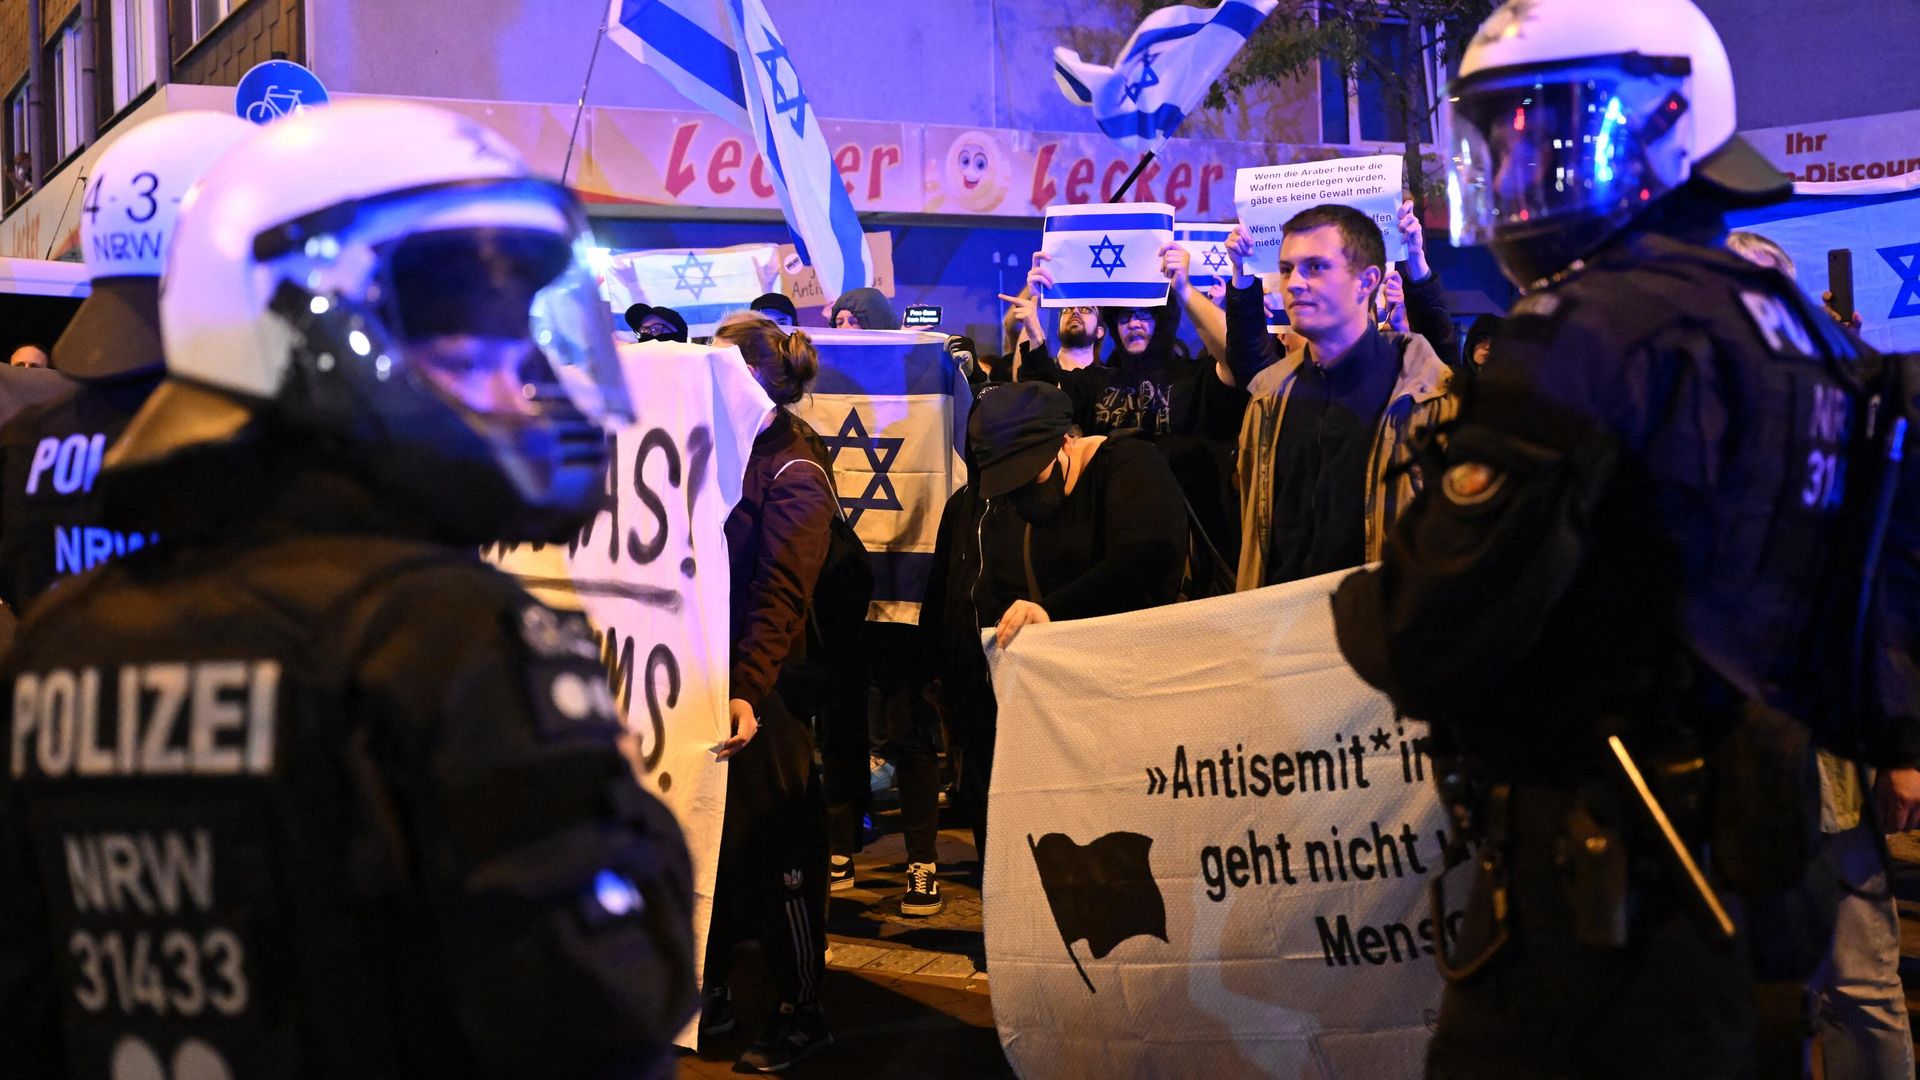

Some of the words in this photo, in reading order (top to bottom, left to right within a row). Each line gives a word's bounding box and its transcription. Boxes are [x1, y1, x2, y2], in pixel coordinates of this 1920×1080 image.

[664, 123, 899, 200] Lecer
[1031, 143, 1224, 212] Lecker
[1254, 172, 1281, 180] Wenn
[1284, 170, 1298, 178] die
[1301, 168, 1335, 176] Araber
[1337, 164, 1365, 173] heute
[1368, 162, 1383, 170] die
[1785, 132, 1827, 155] Ihr
[1249, 183, 1283, 192] Waffen
[1285, 177, 1343, 189] niederlegen
[1346, 173, 1386, 183] würden,
[1250, 195, 1274, 207] gäbe
[1276, 195, 1288, 203] es
[1290, 192, 1317, 202] keine
[1319, 187, 1353, 199] Gewalt
[1356, 185, 1385, 195] mehr.
[1249, 224, 1277, 234] Wenn
[12, 661, 281, 778] POLIZEI
[64, 830, 214, 913] NRW
[1200, 829, 1297, 901] geht
[1305, 821, 1428, 883] nicht
[69, 929, 248, 1016] 31433
